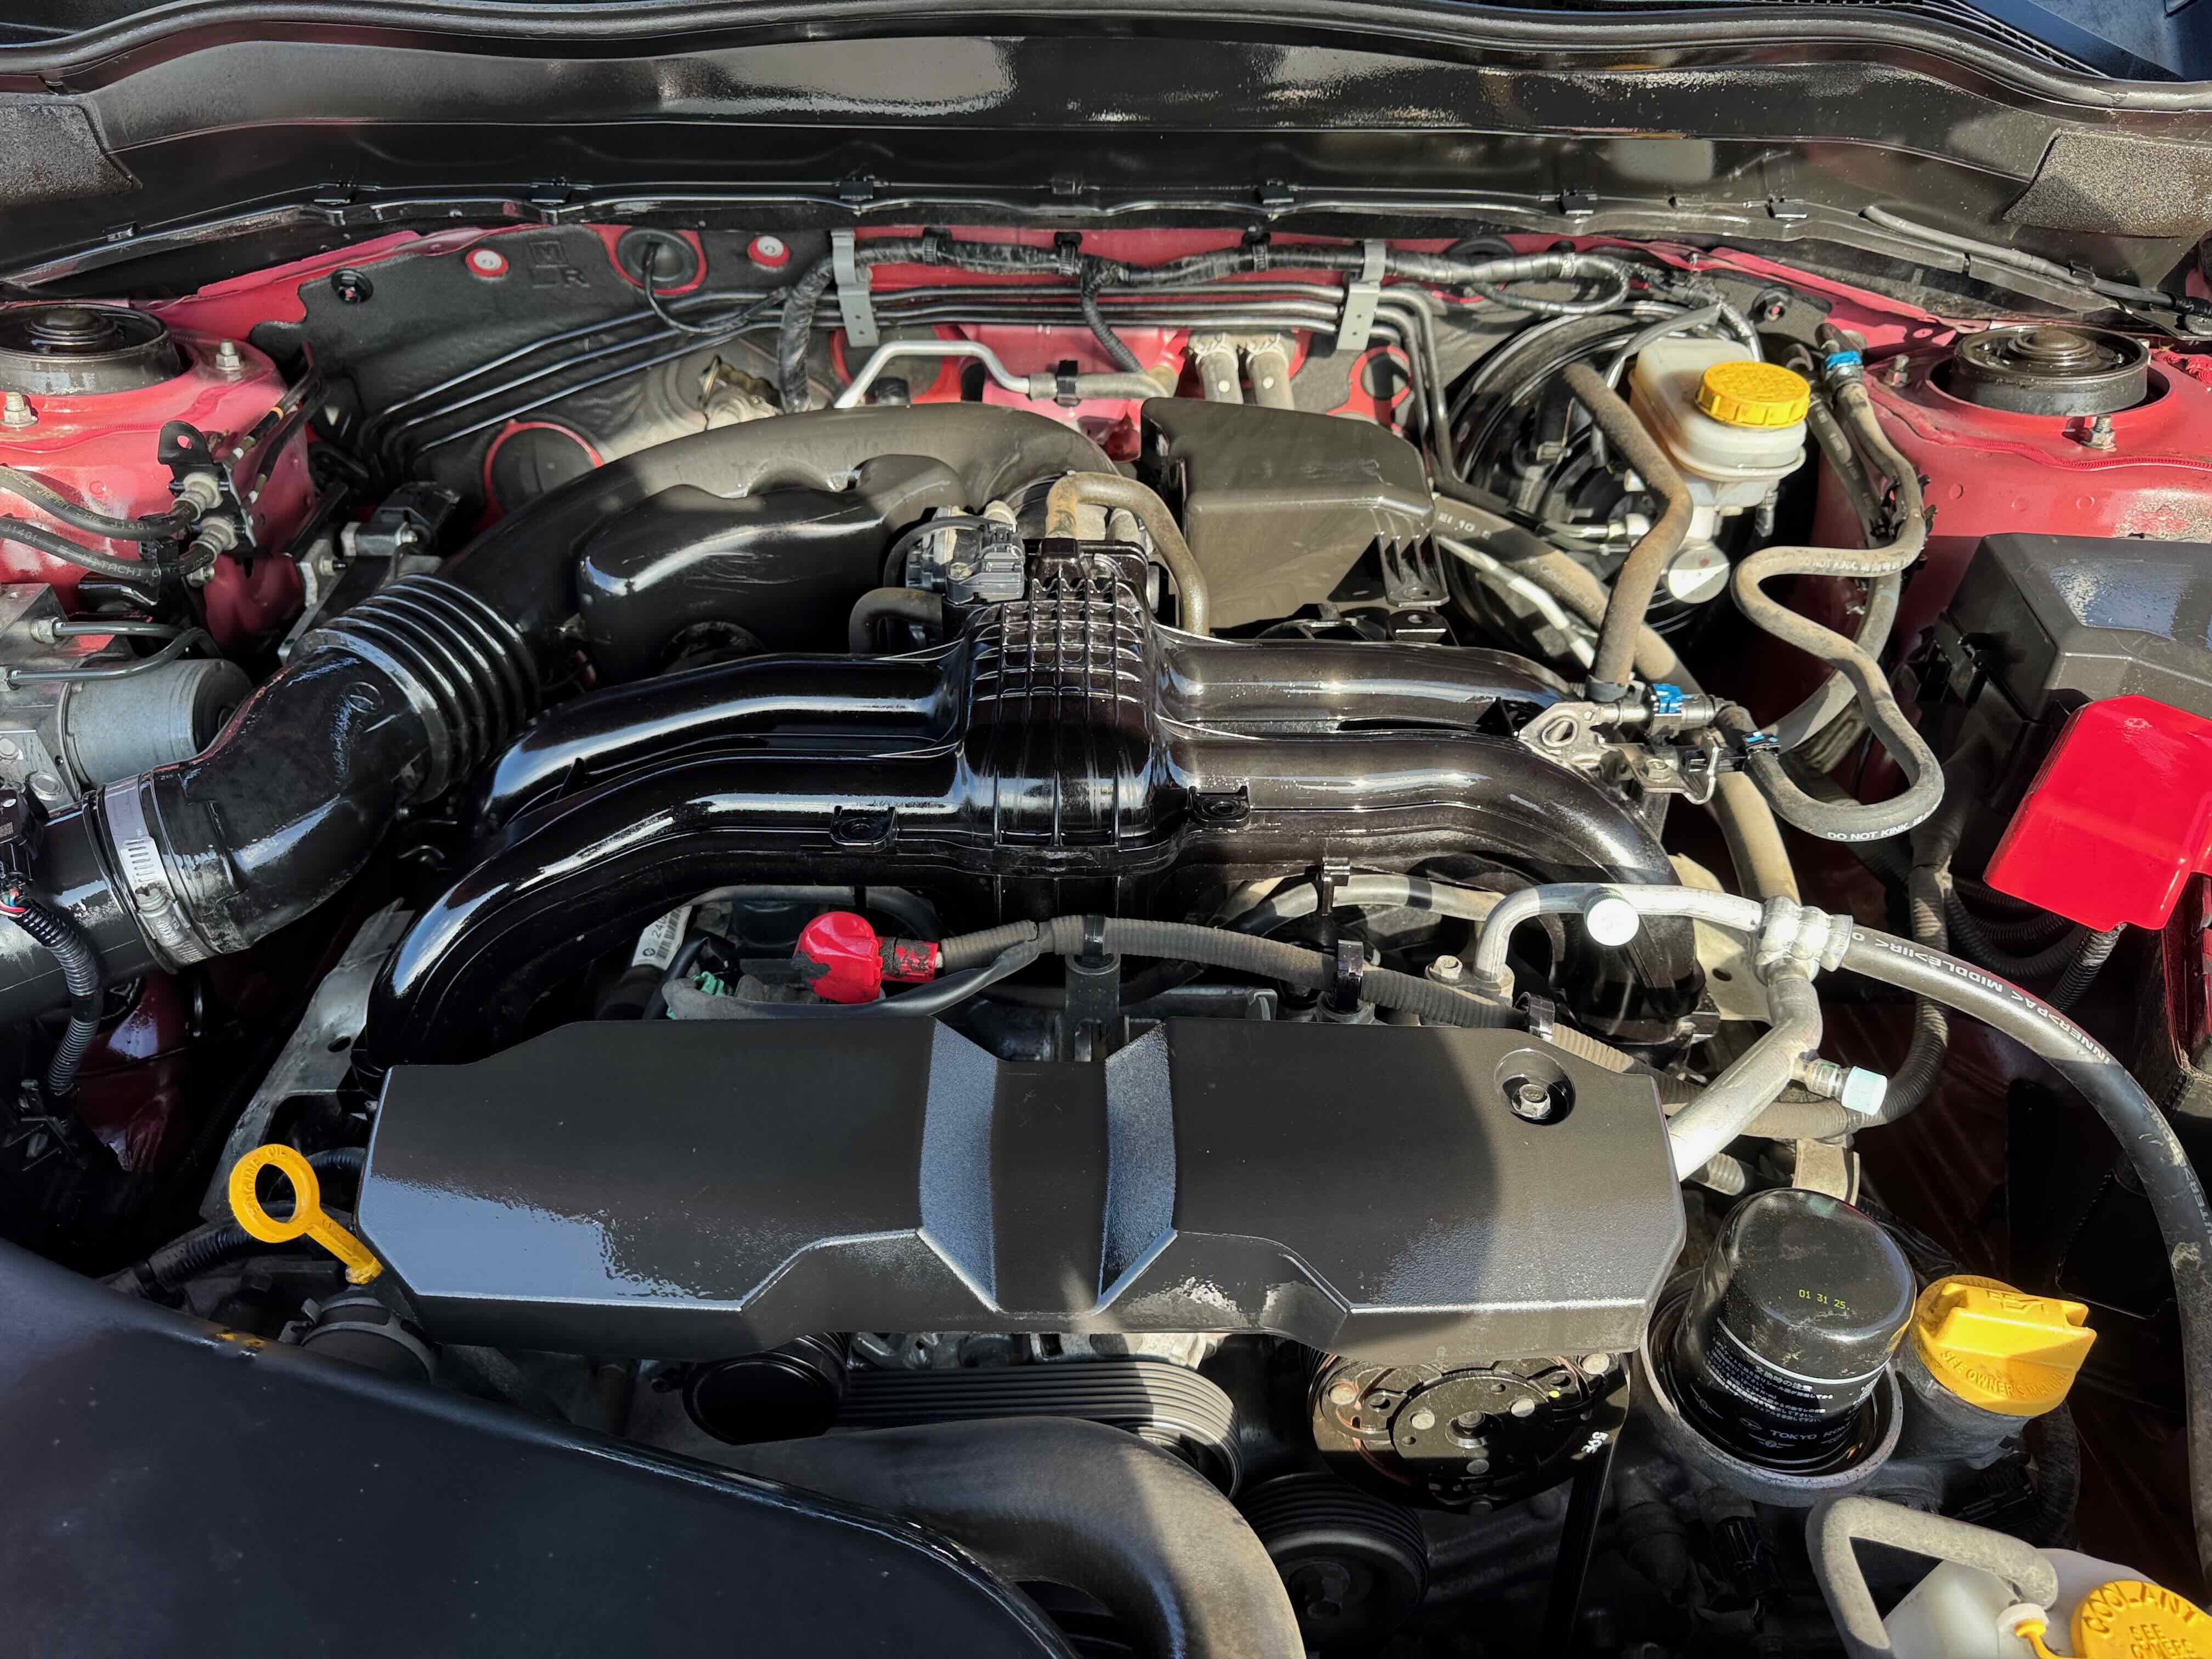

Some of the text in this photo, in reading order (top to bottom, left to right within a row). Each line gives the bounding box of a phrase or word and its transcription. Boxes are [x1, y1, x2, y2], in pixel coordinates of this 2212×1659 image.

[1827, 822, 1910, 840] DO NOT KINK
[1875, 938, 2003, 992] MIDDLE>IIR<
[1799, 1289, 1811, 1299] 01
[1816, 1293, 1827, 1304] 31
[1940, 1350, 2068, 1397] SEE OWNER'S MANUAL
[1770, 1429, 1817, 1440] TOKYO
[2082, 1582, 2196, 1633] COOLANT
[2129, 1623, 2165, 1641] SEE
